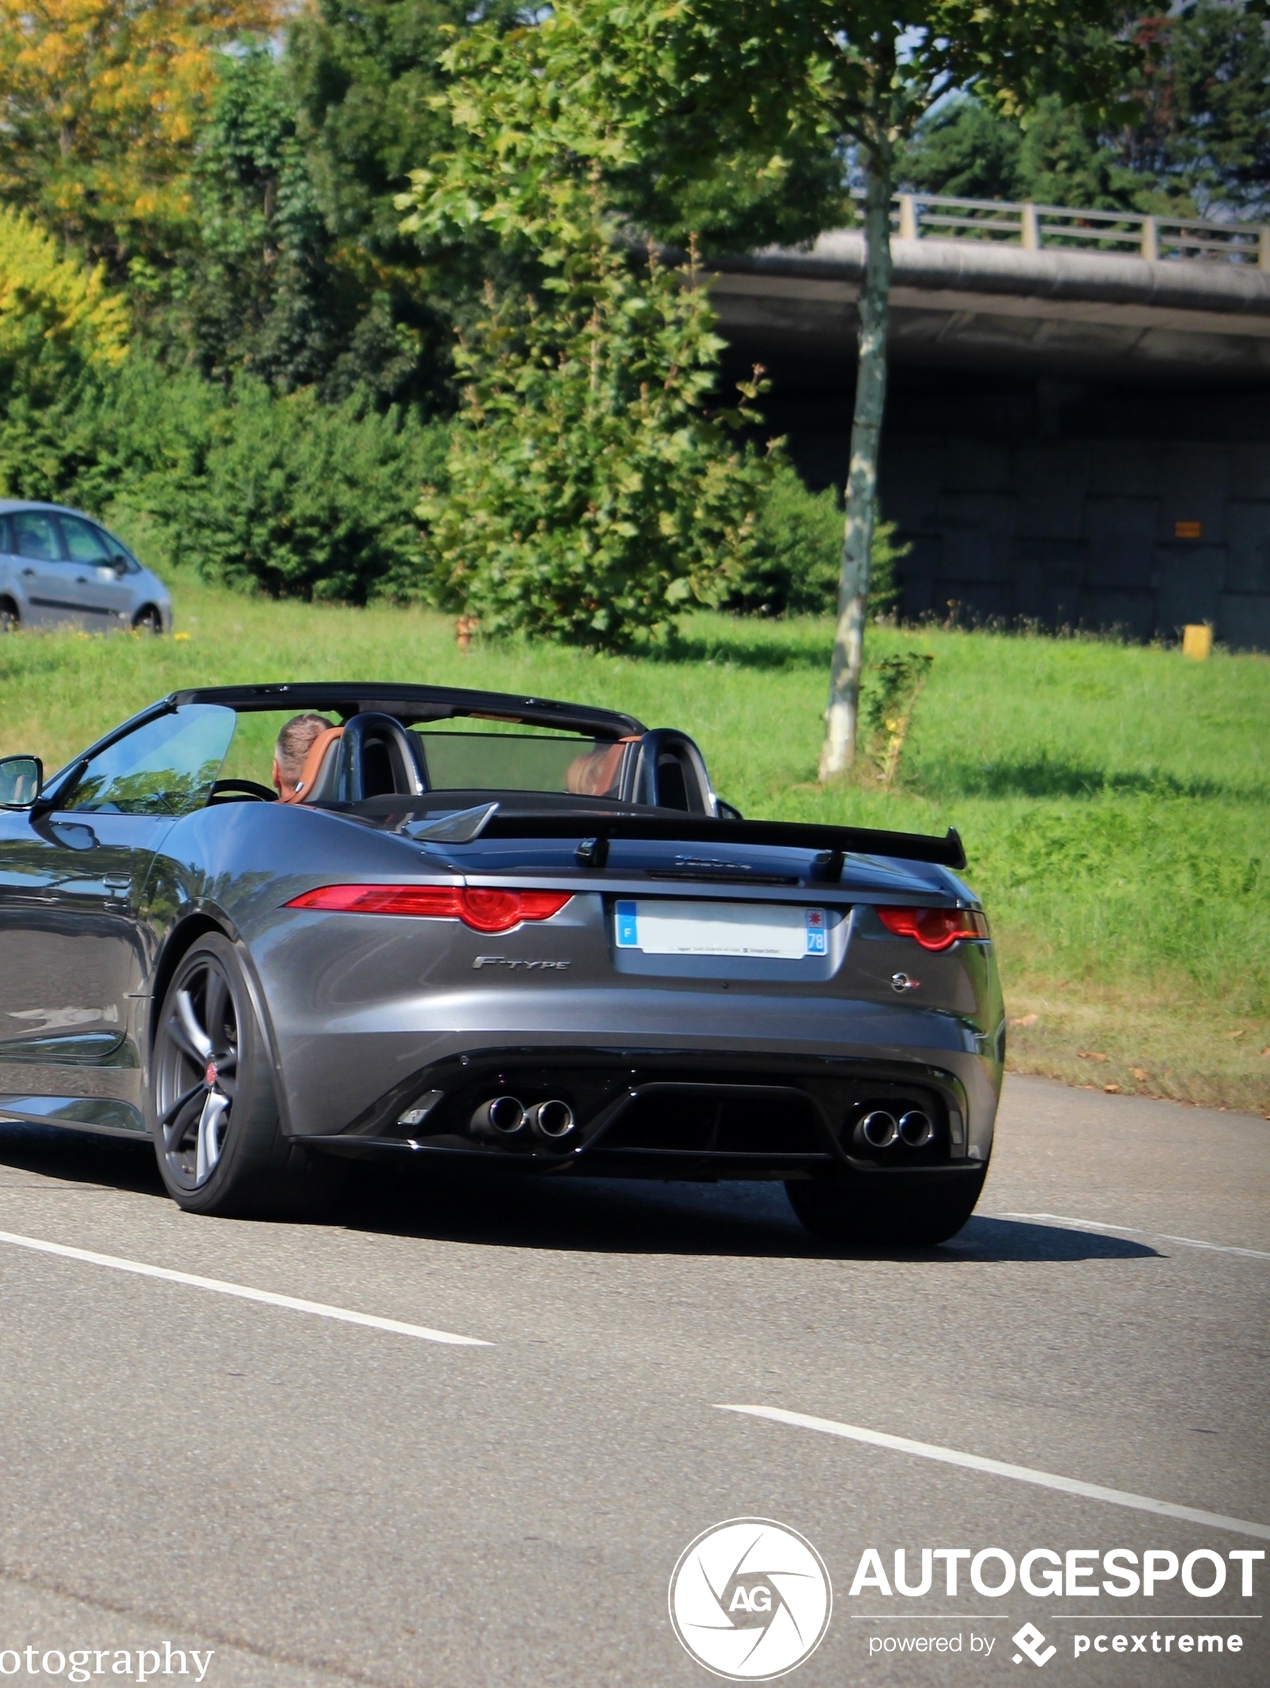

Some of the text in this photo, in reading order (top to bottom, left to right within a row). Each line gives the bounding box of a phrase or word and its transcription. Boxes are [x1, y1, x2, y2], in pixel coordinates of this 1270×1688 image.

[624, 928, 631, 937] F
[808, 933, 824, 949] 78
[472, 955, 571, 970] F-TYPE
